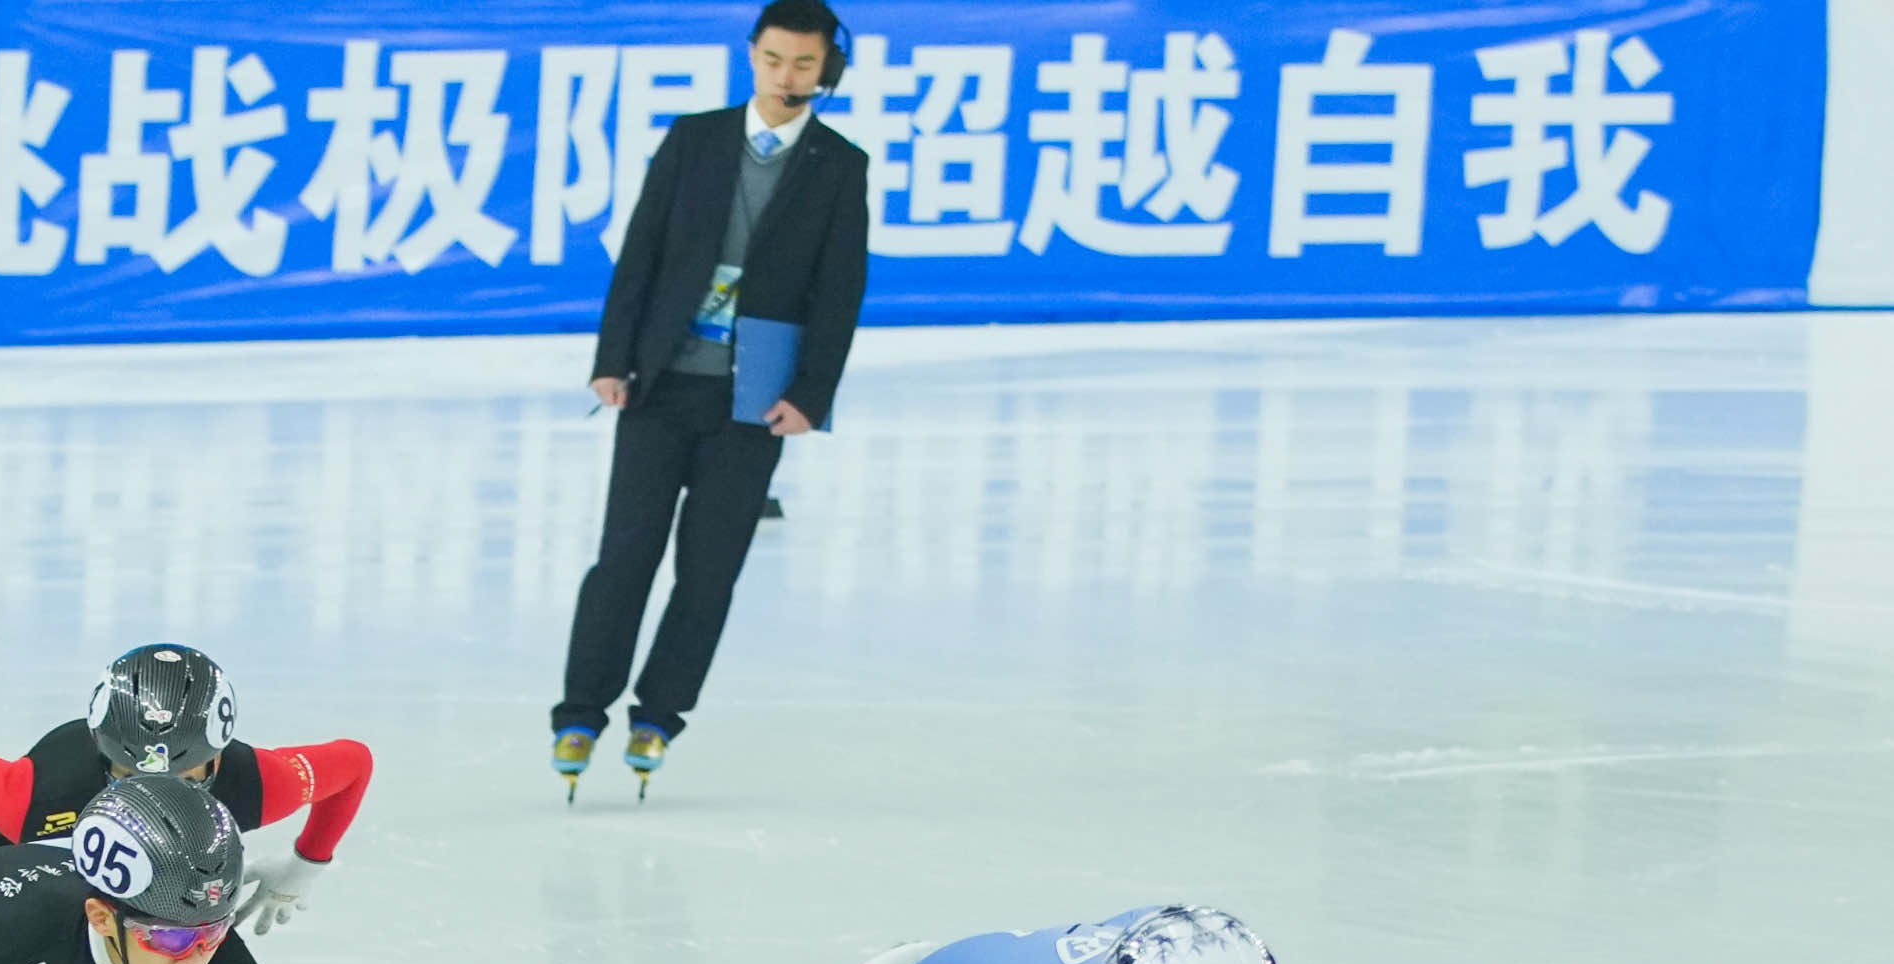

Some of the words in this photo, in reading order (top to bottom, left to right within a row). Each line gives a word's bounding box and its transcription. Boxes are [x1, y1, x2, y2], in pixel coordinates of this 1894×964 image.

[820, 28, 1673, 258] 超越自我
[80, 825, 138, 895] 95
